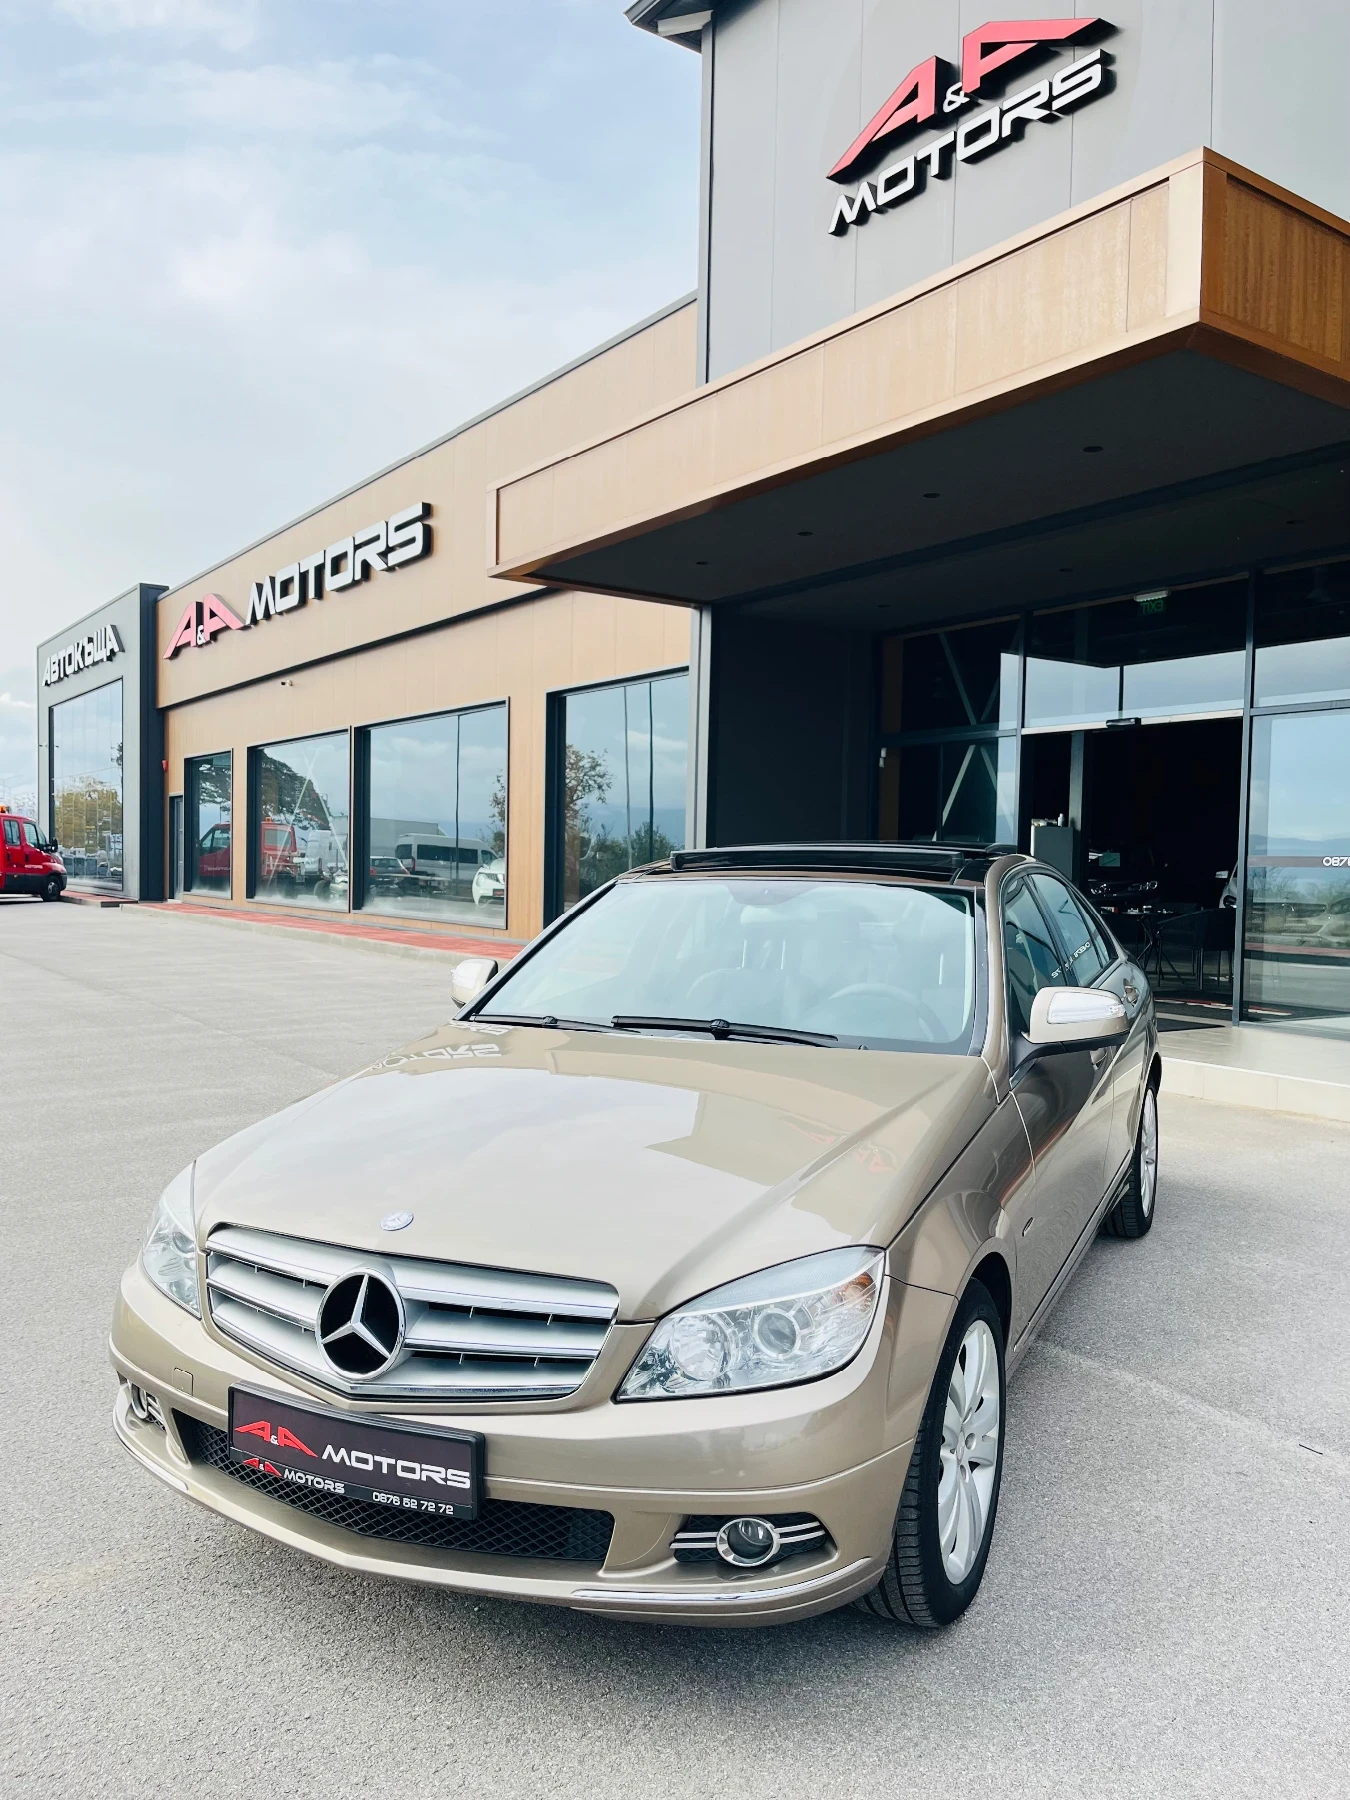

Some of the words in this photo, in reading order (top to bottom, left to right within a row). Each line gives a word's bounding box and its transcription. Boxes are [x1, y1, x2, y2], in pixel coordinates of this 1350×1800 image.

[828, 49, 1106, 235] MOTORS
[162, 593, 246, 660] A&A
[246, 502, 429, 626] MOTORS
[42, 624, 122, 687] АВТОКЪЩА
[1322, 856, 1350, 867] 087
[234, 1420, 319, 1458] A&A
[322, 1444, 471, 1489] MOTORS
[283, 1468, 346, 1494] MOTORS
[372, 1491, 401, 1506] 0876
[402, 1497, 418, 1509] 52
[420, 1500, 436, 1512] 72
[438, 1503, 454, 1515] 72
